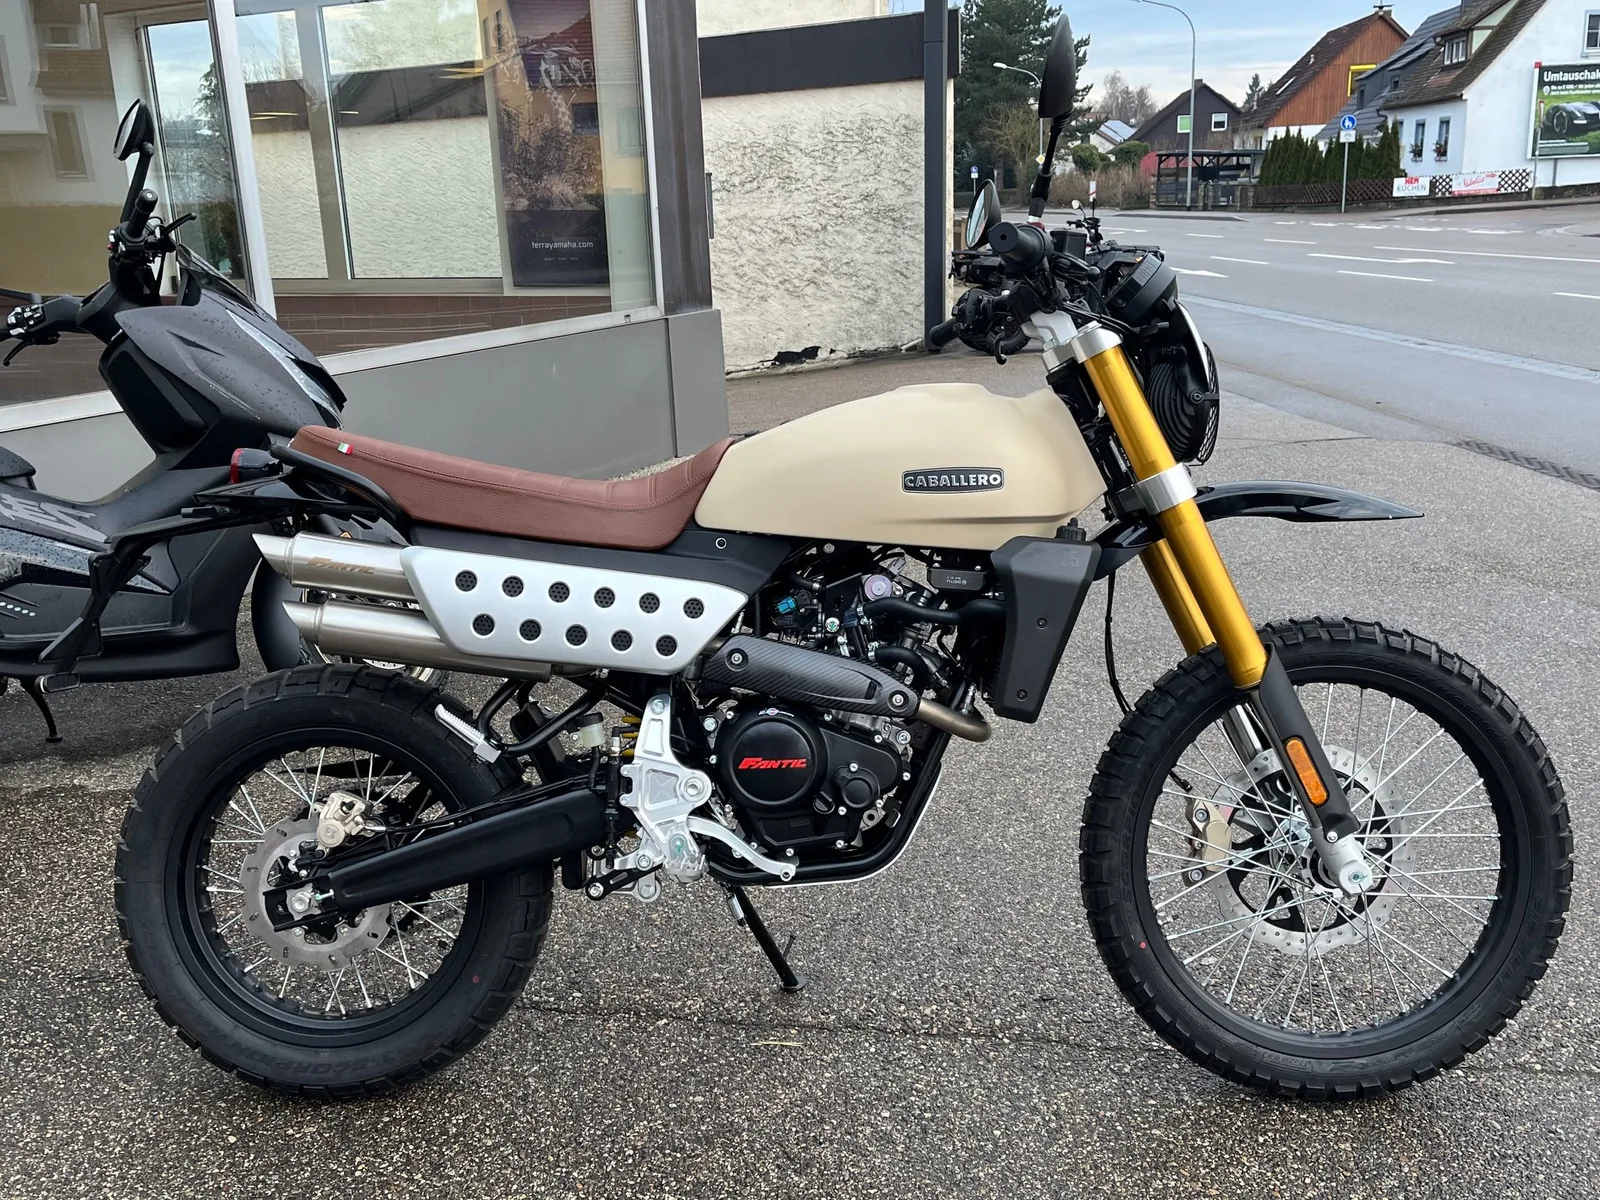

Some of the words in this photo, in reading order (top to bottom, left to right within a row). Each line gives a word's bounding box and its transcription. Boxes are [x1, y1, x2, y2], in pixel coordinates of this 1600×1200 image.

[531, 240, 593, 250] terrayamaha.com
[904, 473, 1002, 488] CABALLERO
[305, 556, 376, 575] FANTIC
[738, 757, 807, 769] FANTIC
